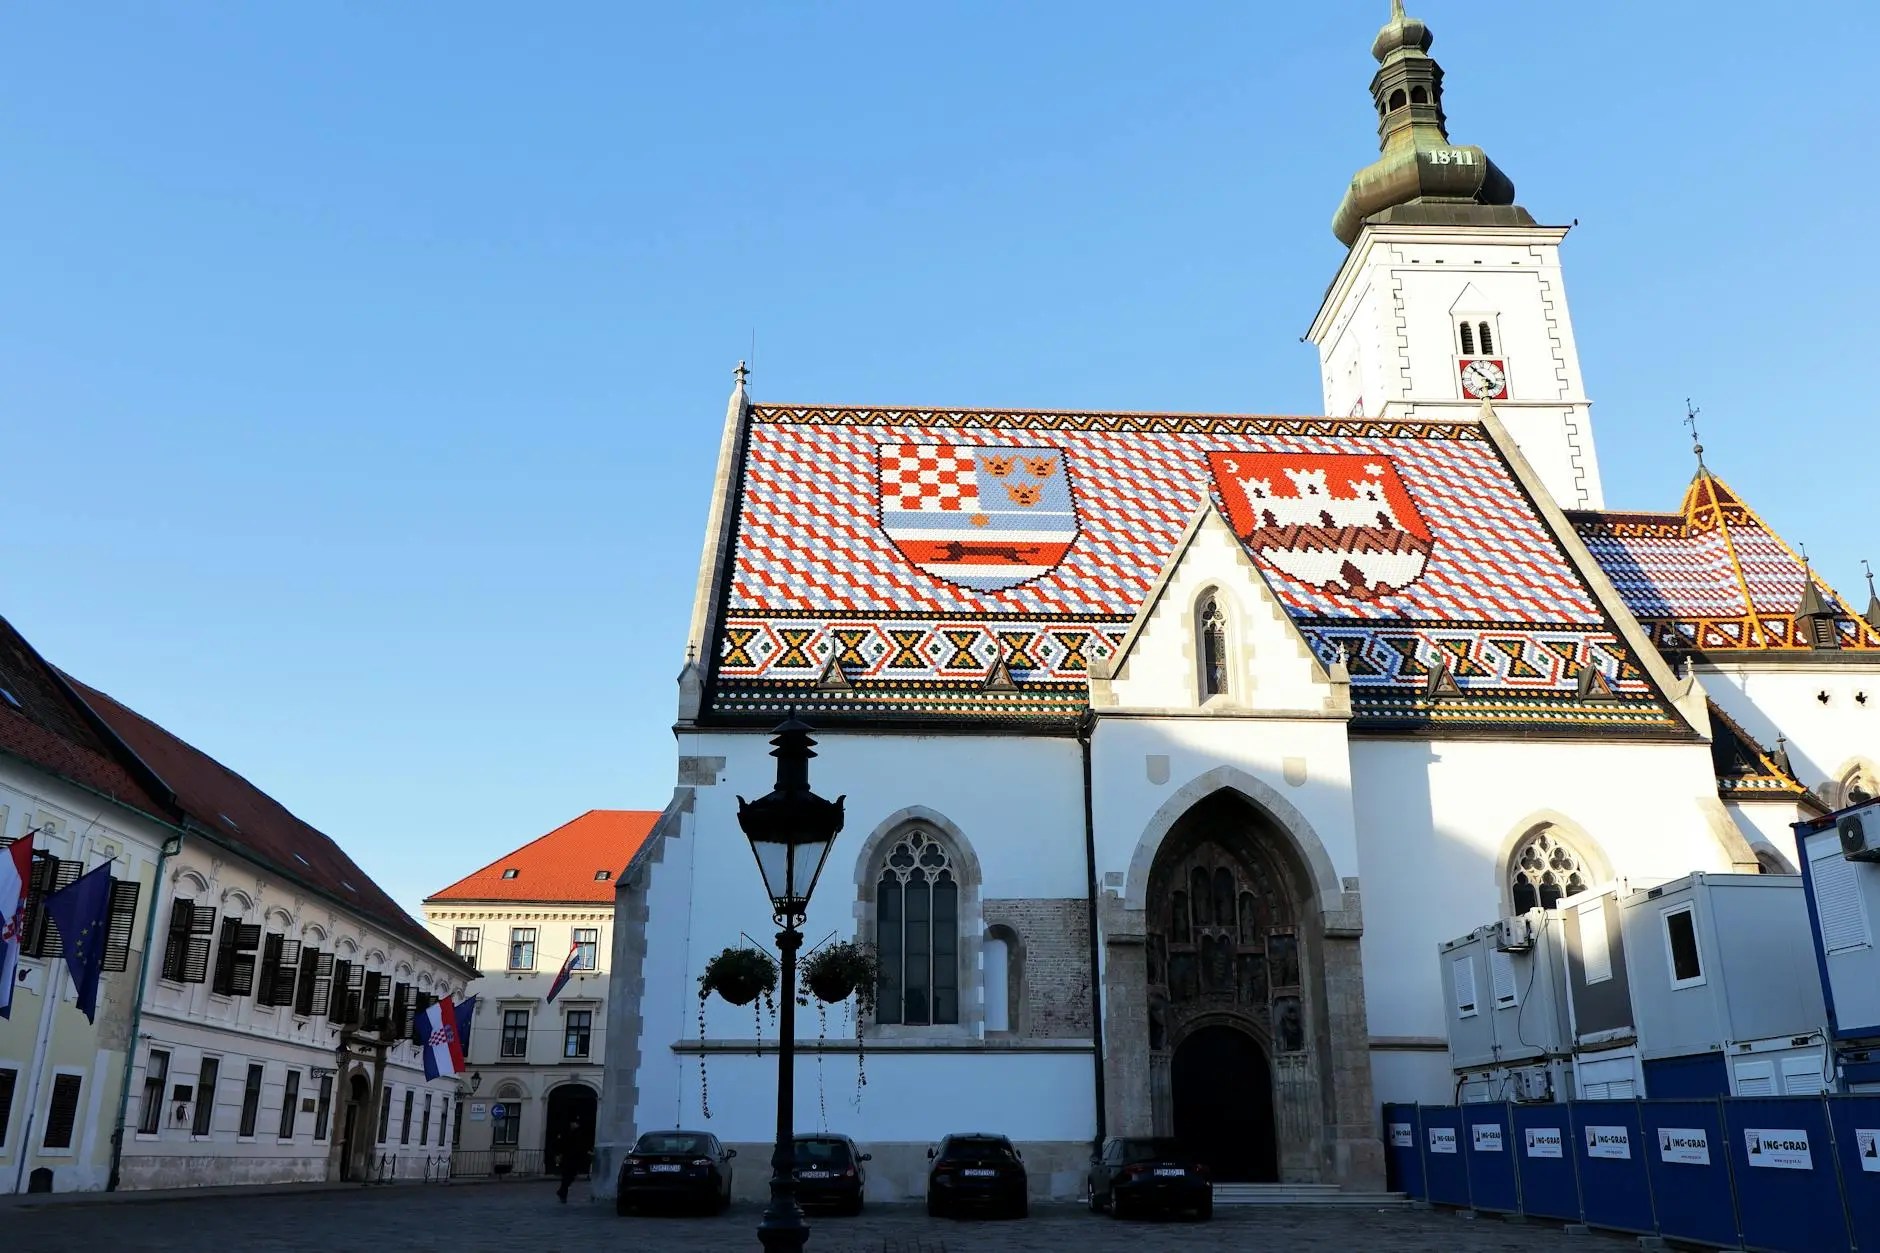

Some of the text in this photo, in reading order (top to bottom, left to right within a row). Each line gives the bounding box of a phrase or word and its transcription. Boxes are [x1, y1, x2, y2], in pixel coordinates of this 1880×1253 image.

[1536, 1136, 1560, 1144] ING-GRAD
[1597, 1135, 1627, 1144] ING-GRAD
[1672, 1138, 1706, 1148] ING-GRAD
[1763, 1140, 1807, 1151] ING-GRAD
